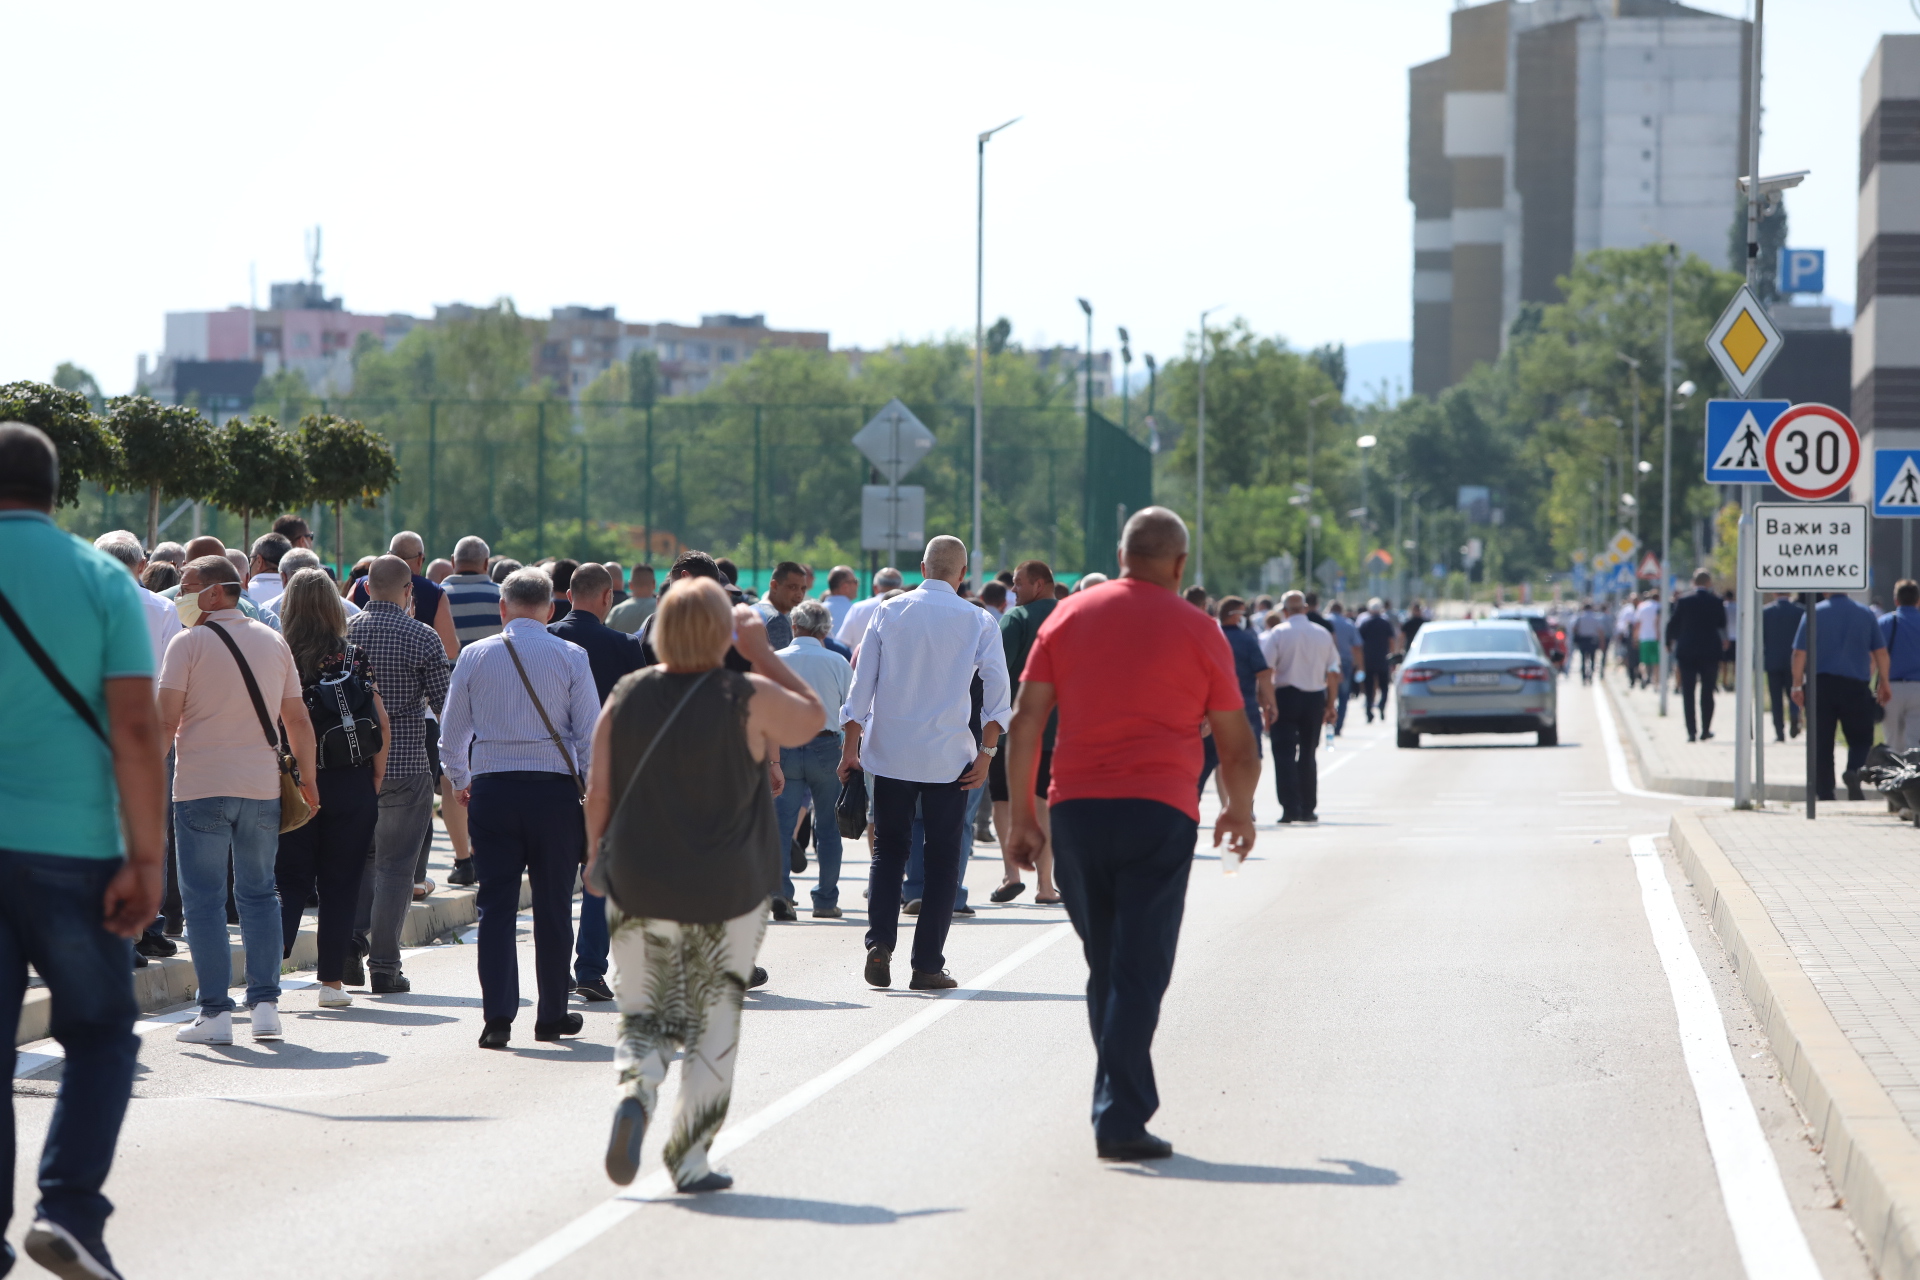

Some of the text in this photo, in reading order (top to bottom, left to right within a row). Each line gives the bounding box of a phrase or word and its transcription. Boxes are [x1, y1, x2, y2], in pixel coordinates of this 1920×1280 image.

[1791, 252, 1819, 287] P
[1785, 430, 1840, 475] 30
[1766, 518, 1852, 535] Важи за
[1778, 543, 1839, 558] целия
[1762, 564, 1860, 577] комплекс
